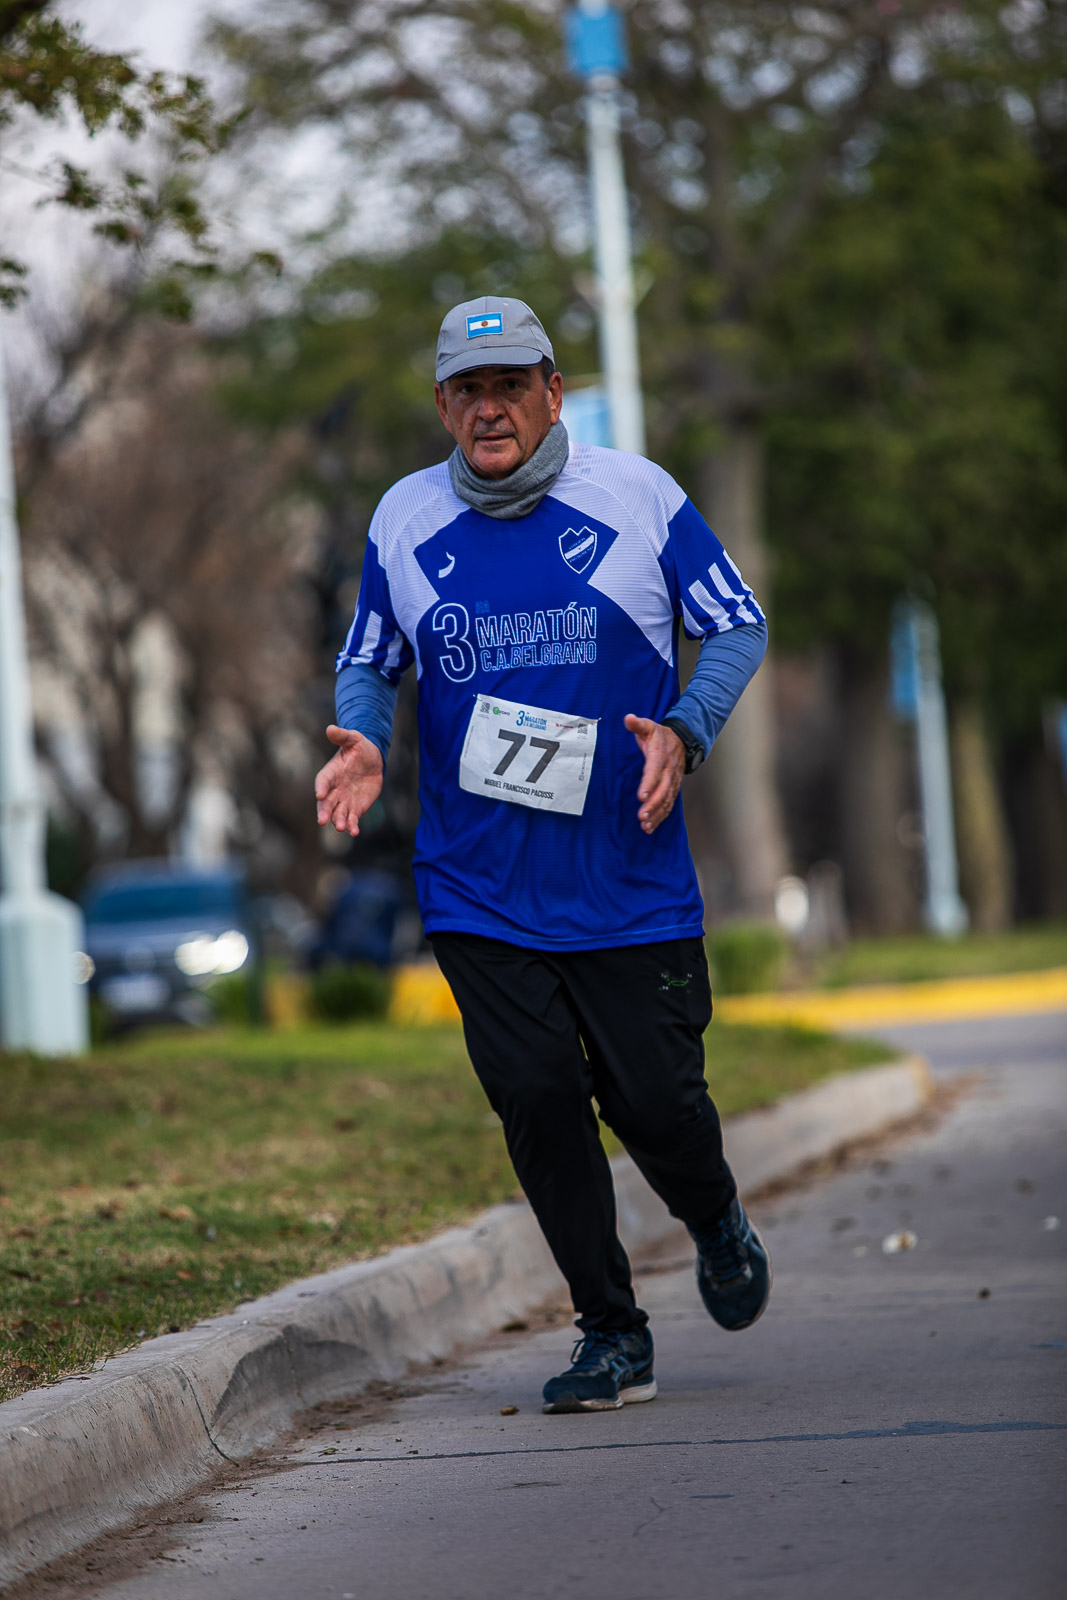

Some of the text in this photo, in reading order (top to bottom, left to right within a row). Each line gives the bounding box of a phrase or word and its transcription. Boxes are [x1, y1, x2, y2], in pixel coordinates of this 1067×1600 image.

[432, 602, 477, 683] 3
[475, 601, 597, 648] MARATÓN
[516, 710, 525, 727] 3
[493, 728, 560, 784] 77
[484, 777, 502, 789] MIGUEL
[502, 781, 531, 795] FRANCISCO
